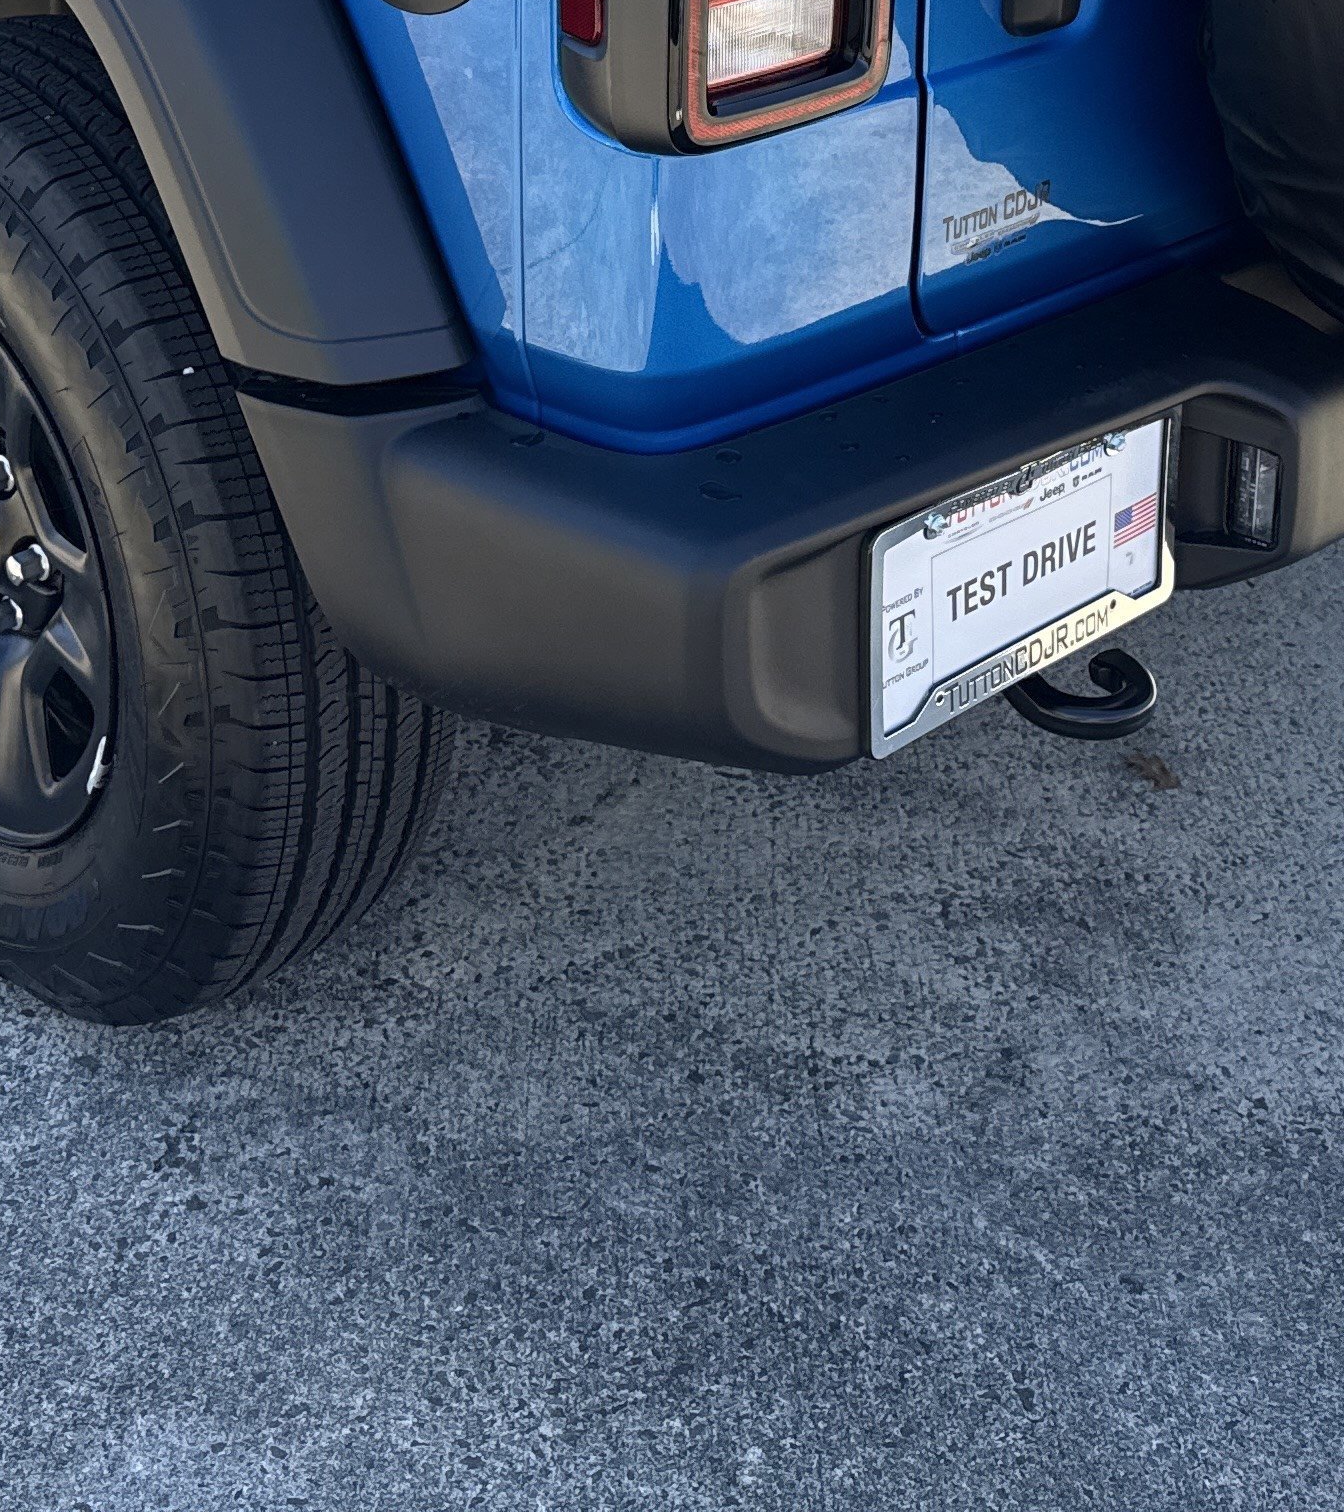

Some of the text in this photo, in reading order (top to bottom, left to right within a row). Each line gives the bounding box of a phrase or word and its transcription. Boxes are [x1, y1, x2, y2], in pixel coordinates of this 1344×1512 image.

[942, 203, 999, 243] TUTTON
[1003, 179, 1051, 220] CDJR
[1039, 482, 1066, 502] Jeep
[946, 520, 1097, 623] TEST DRIVE
[882, 671, 905, 690] UTTON
[945, 605, 1109, 715] TUTTONCDJR.COM
